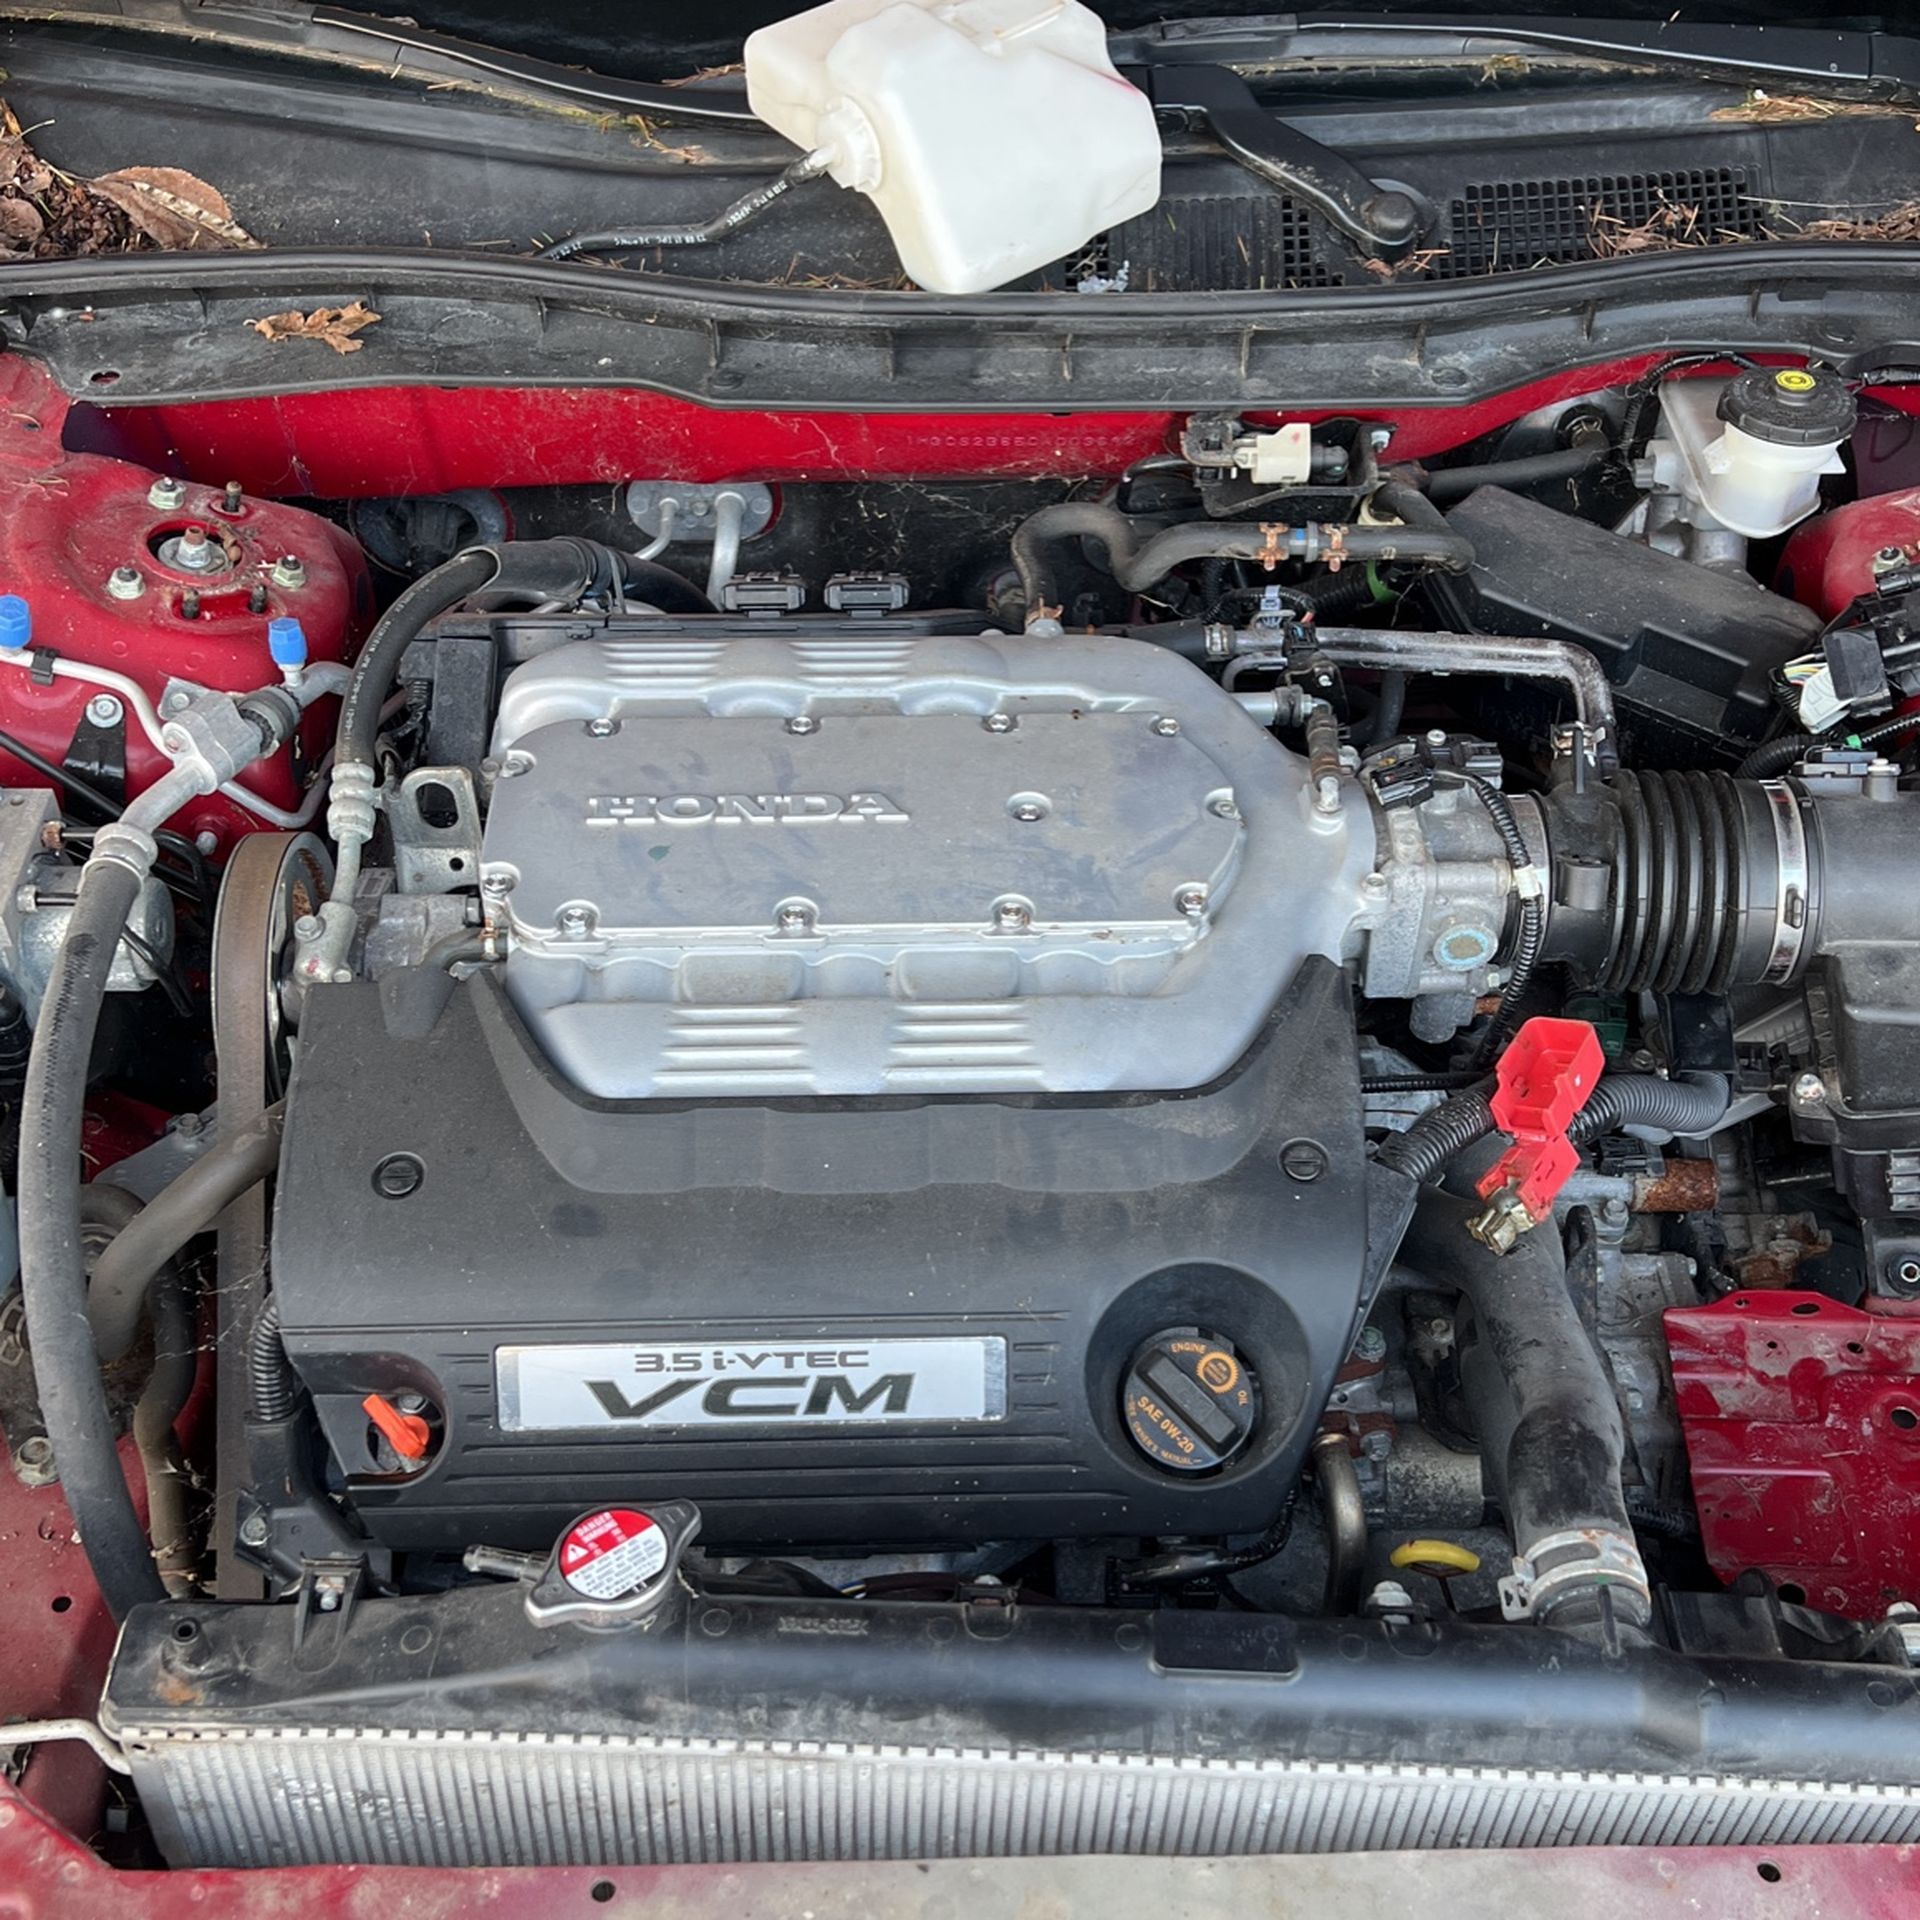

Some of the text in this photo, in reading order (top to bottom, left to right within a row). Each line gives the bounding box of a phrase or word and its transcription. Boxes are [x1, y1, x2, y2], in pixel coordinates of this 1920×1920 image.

[586, 794, 909, 824] HONDA
[635, 1350, 869, 1373] 3.5 i-VTEC
[1170, 1342, 1248, 1408] ENGINE OIL
[583, 1373, 916, 1418] VCM
[1137, 1396, 1195, 1454] SAE 0W-20
[575, 1511, 613, 1536] DANGER
